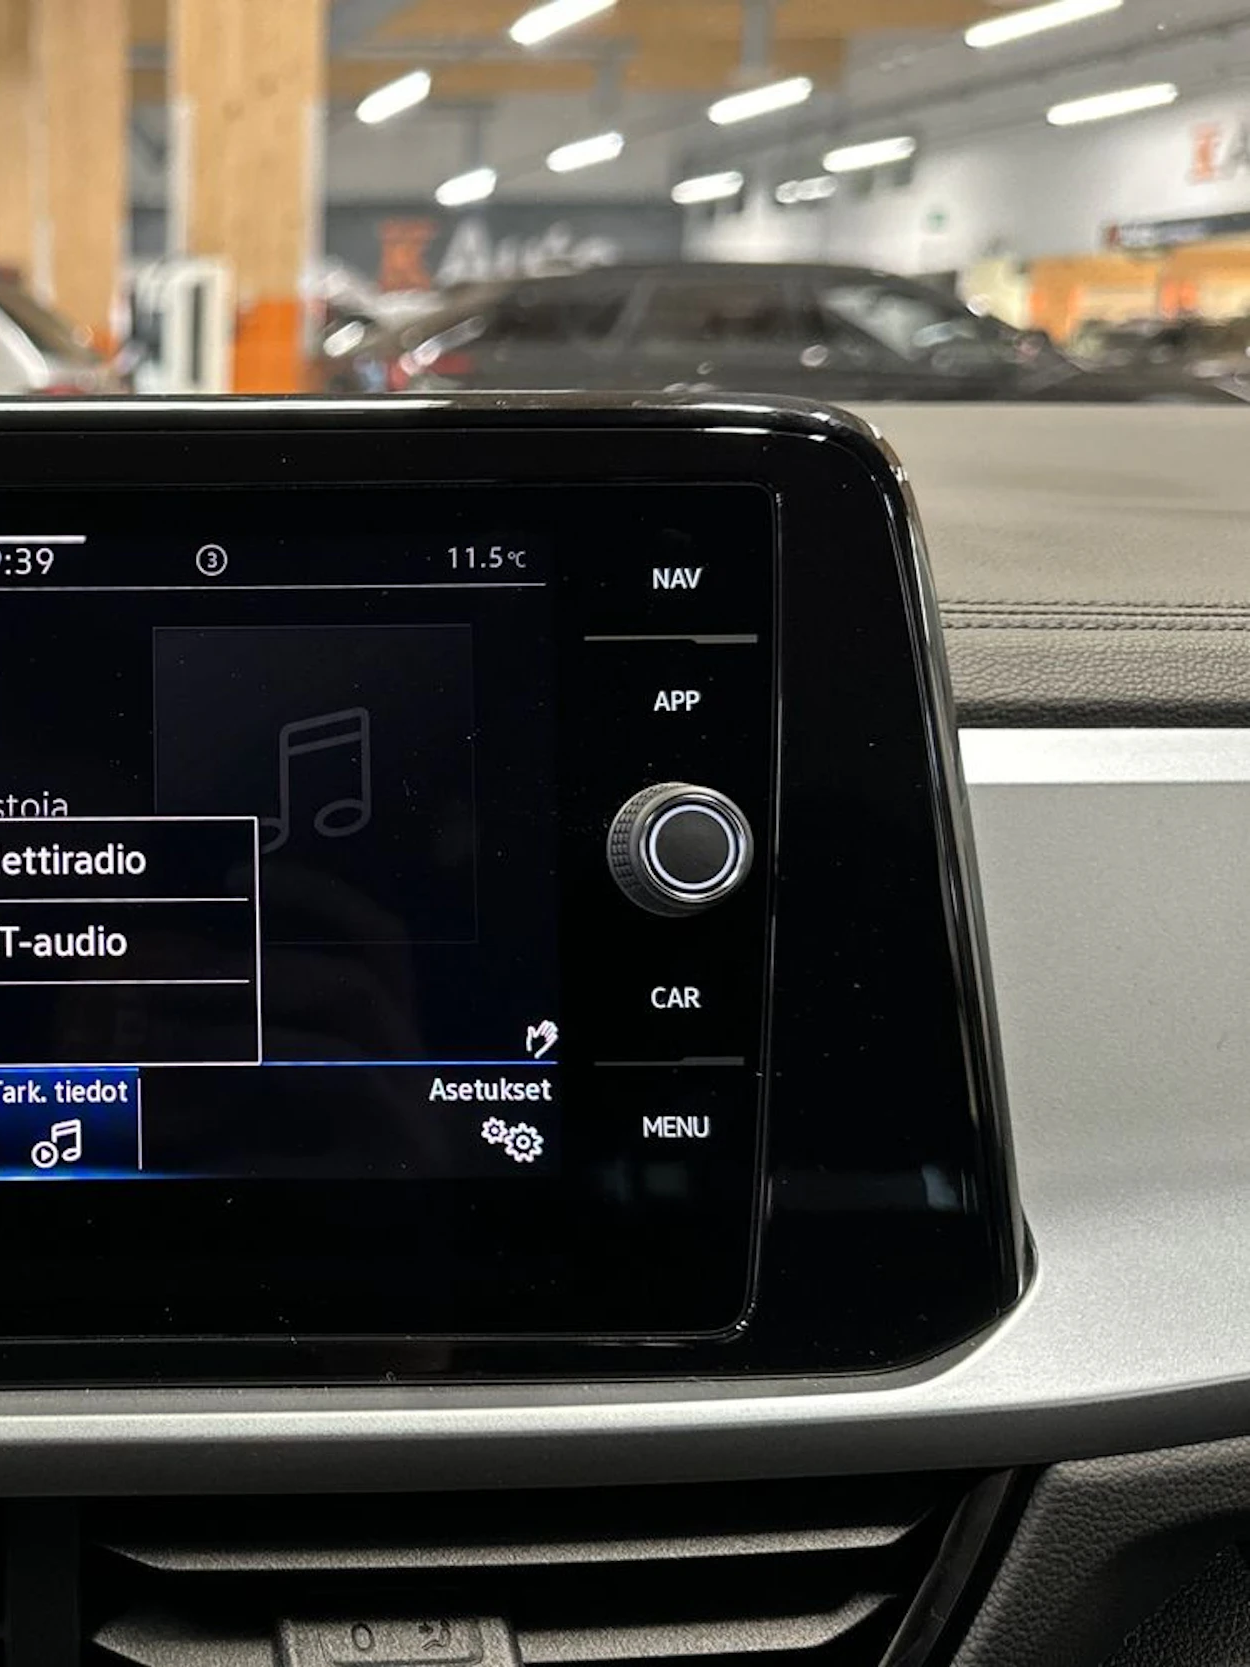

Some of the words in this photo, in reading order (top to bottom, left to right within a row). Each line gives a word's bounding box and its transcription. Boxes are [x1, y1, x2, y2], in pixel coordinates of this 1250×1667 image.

[652, 567, 702, 590] NAV
[653, 689, 701, 712] APP
[650, 986, 701, 1009] CAR
[53, 1079, 128, 1103] tiedot
[428, 1077, 553, 1101] Asetukset
[642, 1115, 710, 1138] MENU
